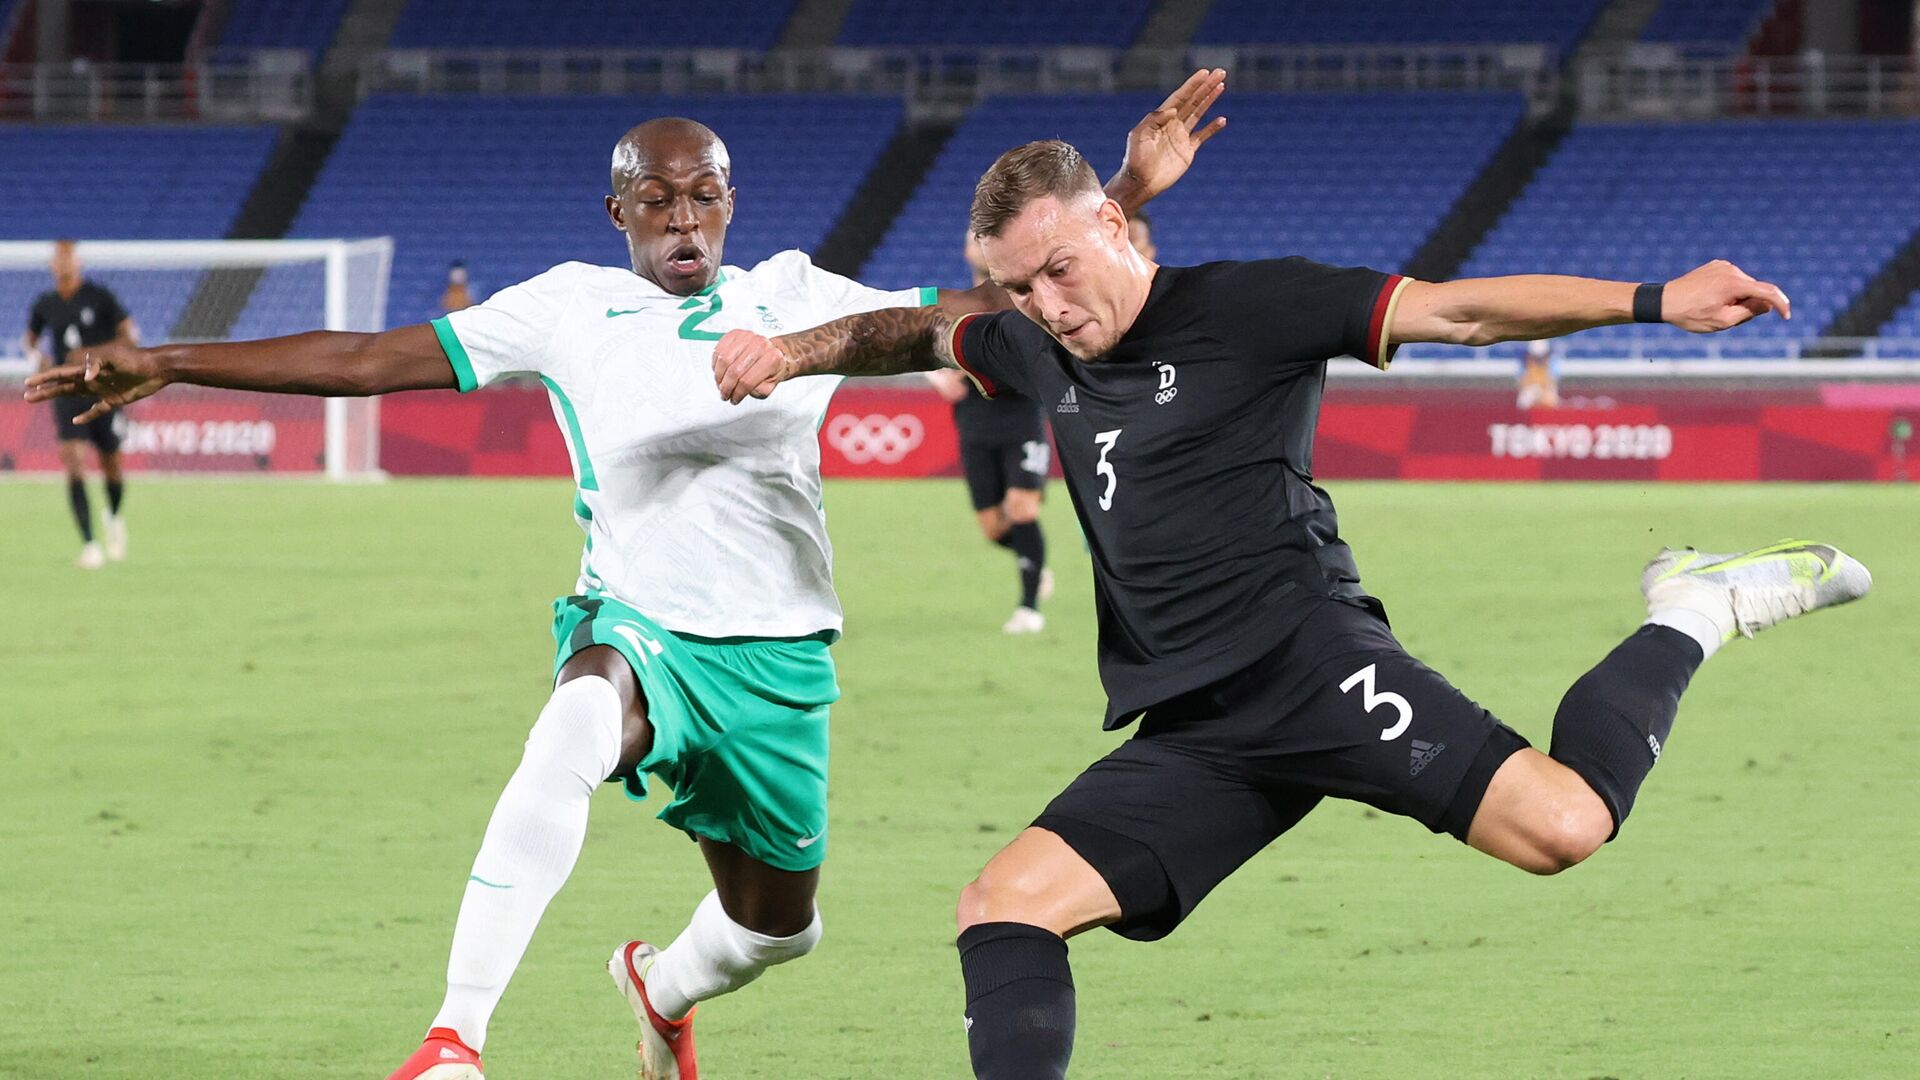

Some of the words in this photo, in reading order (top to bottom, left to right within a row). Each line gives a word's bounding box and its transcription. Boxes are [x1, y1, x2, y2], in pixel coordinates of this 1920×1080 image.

[678, 294, 728, 341] 2
[1158, 364, 1177, 390] D
[201, 420, 276, 455] 2020
[1488, 424, 1593, 459] TOKYO
[1594, 424, 1672, 459] 2020
[1094, 429, 1123, 511] 3
[1339, 663, 1413, 741] 3
[1409, 743, 1446, 776] adidas
